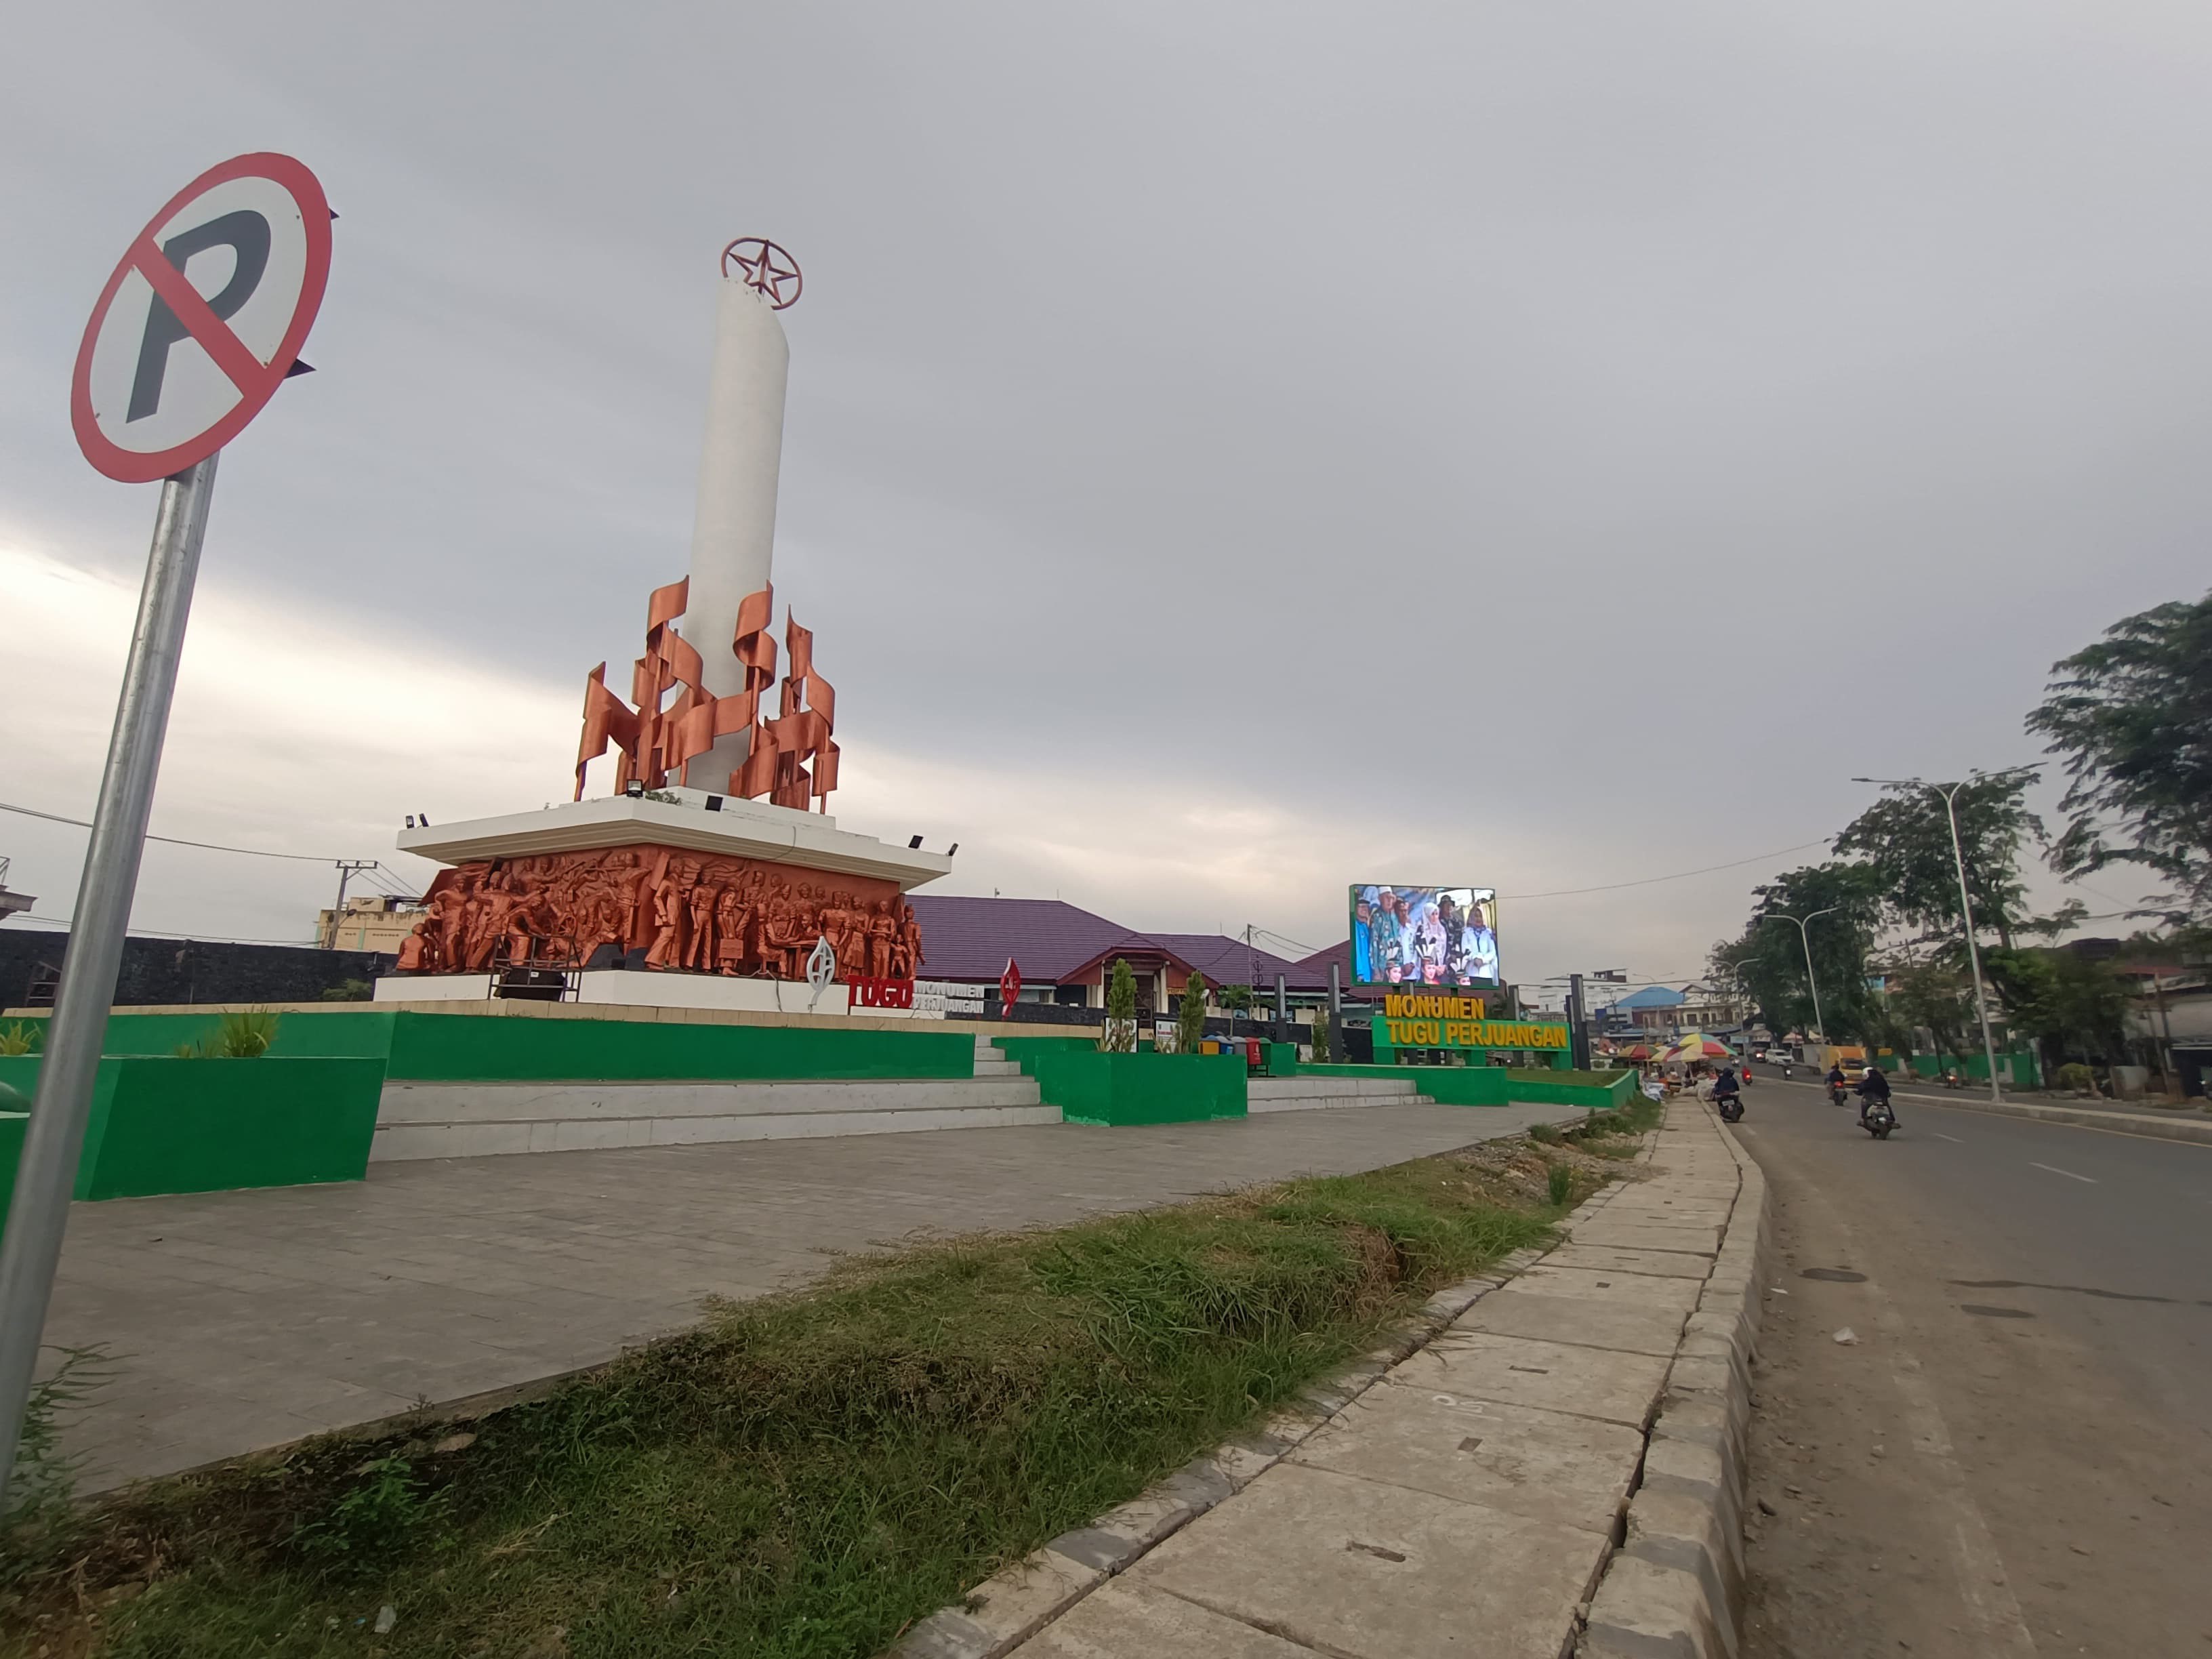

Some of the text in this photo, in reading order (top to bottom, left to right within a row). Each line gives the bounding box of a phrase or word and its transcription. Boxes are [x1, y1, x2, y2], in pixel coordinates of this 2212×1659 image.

[125, 209, 271, 424] P
[847, 975, 914, 1008] TUGU
[914, 980, 985, 999] MONUMEN
[912, 996, 985, 1014] PERJUANGAN
[1385, 994, 1486, 1020] MONUMEN
[1386, 1020, 1568, 1048] TUGU PERJUANGAN
